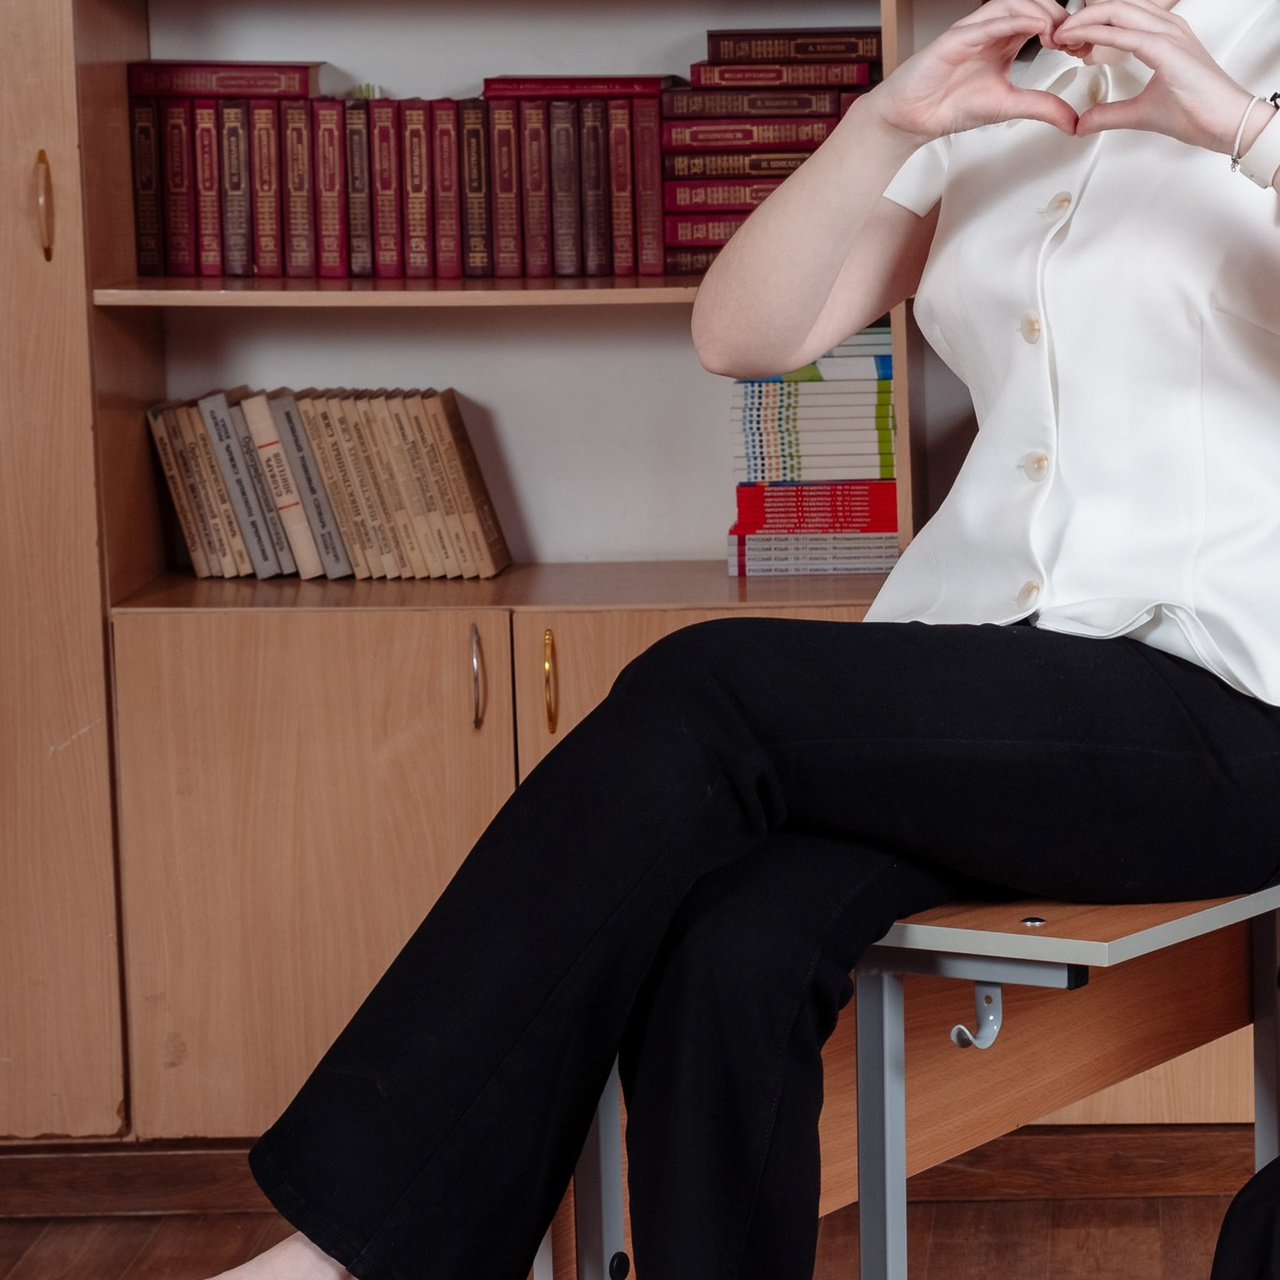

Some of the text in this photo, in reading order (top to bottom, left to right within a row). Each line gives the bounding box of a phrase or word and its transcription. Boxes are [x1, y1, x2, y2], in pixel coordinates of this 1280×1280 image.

[319, 410, 336, 438] СЛОВ
[264, 456, 283, 498] СЛОВАРЬ
[272, 451, 293, 496] ЭПИТЕТОВ
[329, 440, 363, 517] ИНОСТРАННЫХ
